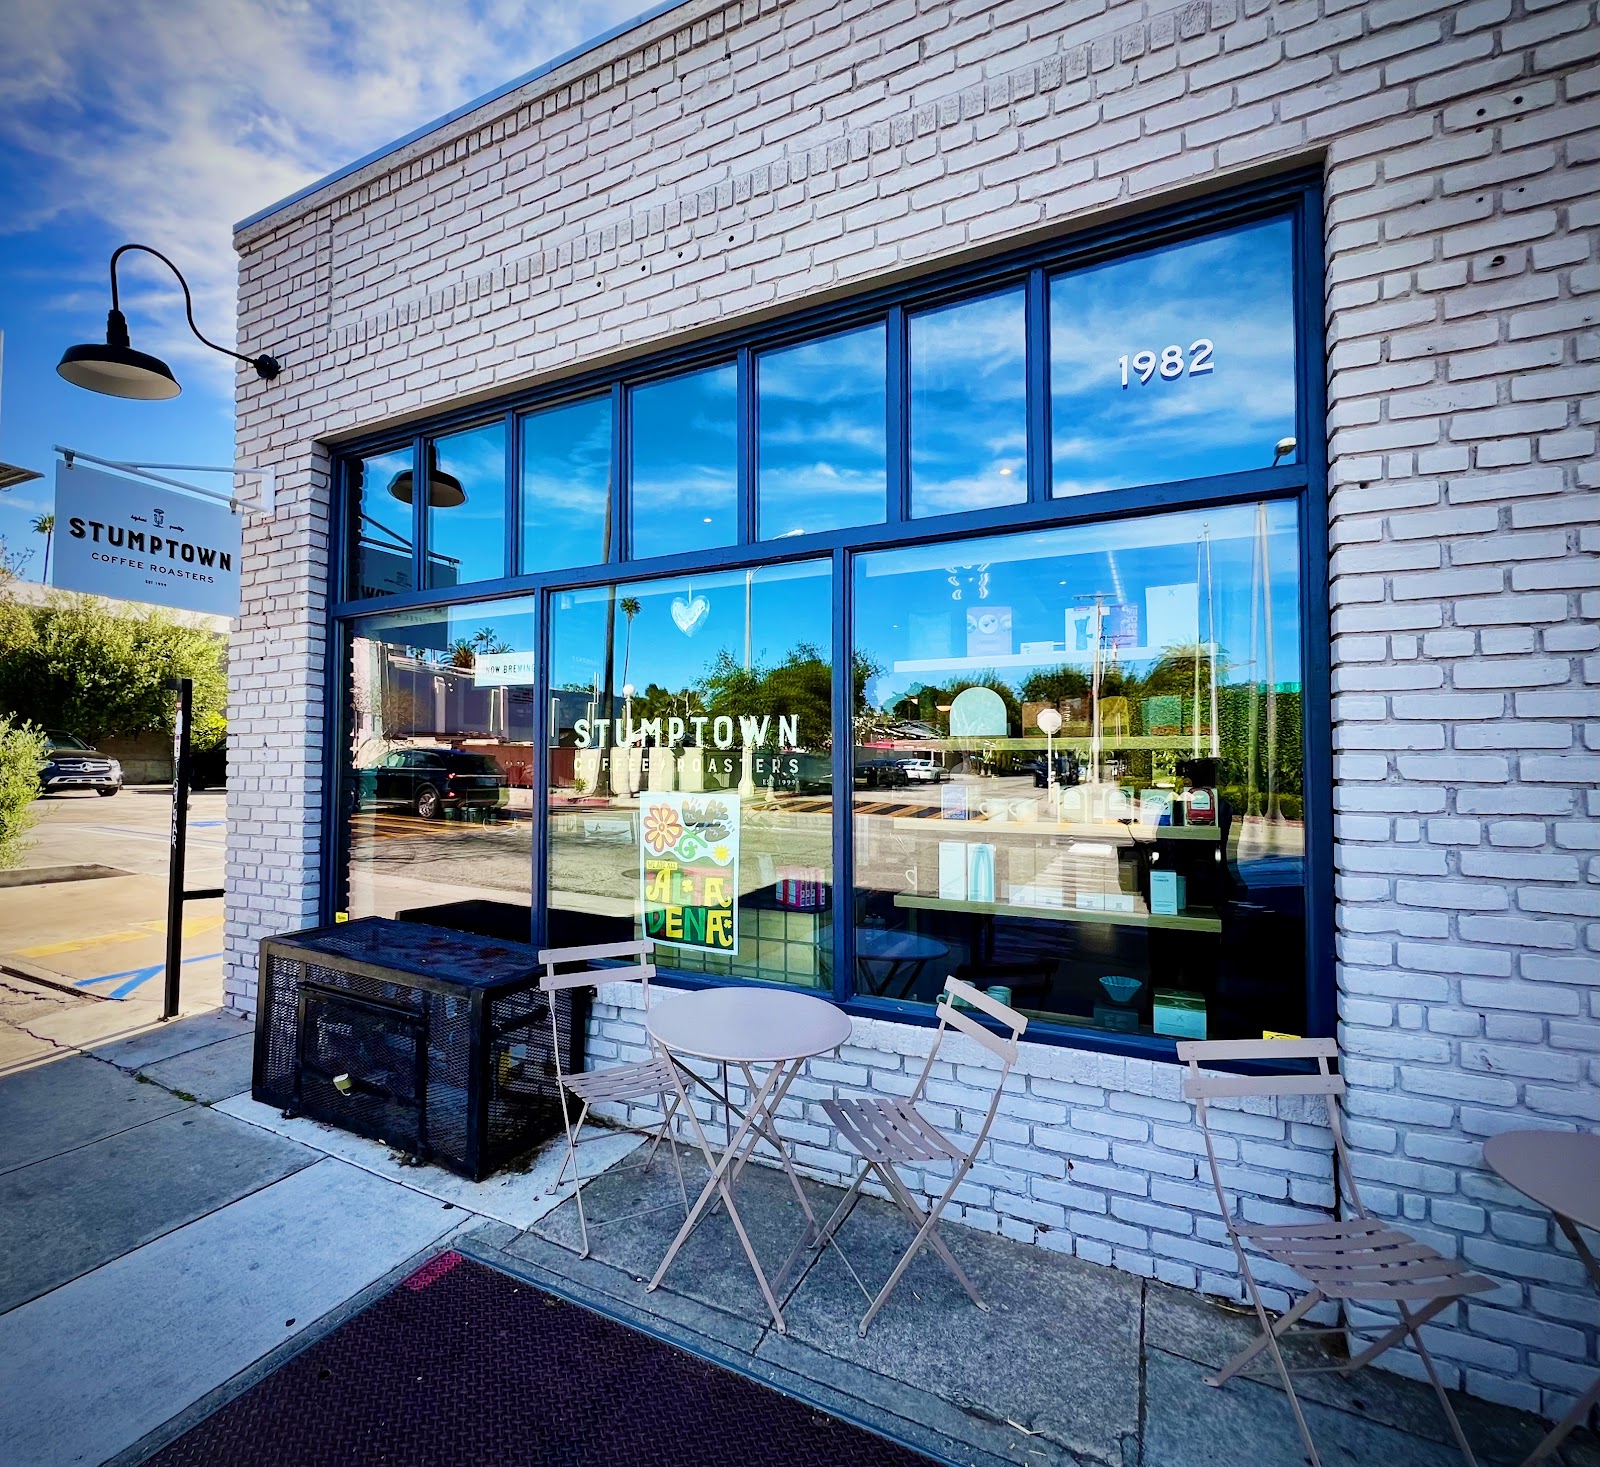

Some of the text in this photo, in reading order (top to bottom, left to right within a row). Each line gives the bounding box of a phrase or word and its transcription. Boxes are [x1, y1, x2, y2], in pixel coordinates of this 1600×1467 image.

[1118, 338, 1215, 389] 1982
[69, 517, 232, 572] STUMPTOWN
[91, 552, 215, 584] COFFEE ROASTERS
[485, 665, 501, 675] NOW
[573, 714, 799, 749] STUMPTOWN
[573, 757, 800, 774] COFFEE ROASTERS
[645, 867, 733, 907] ALTA
[647, 906, 733, 947] DENA
